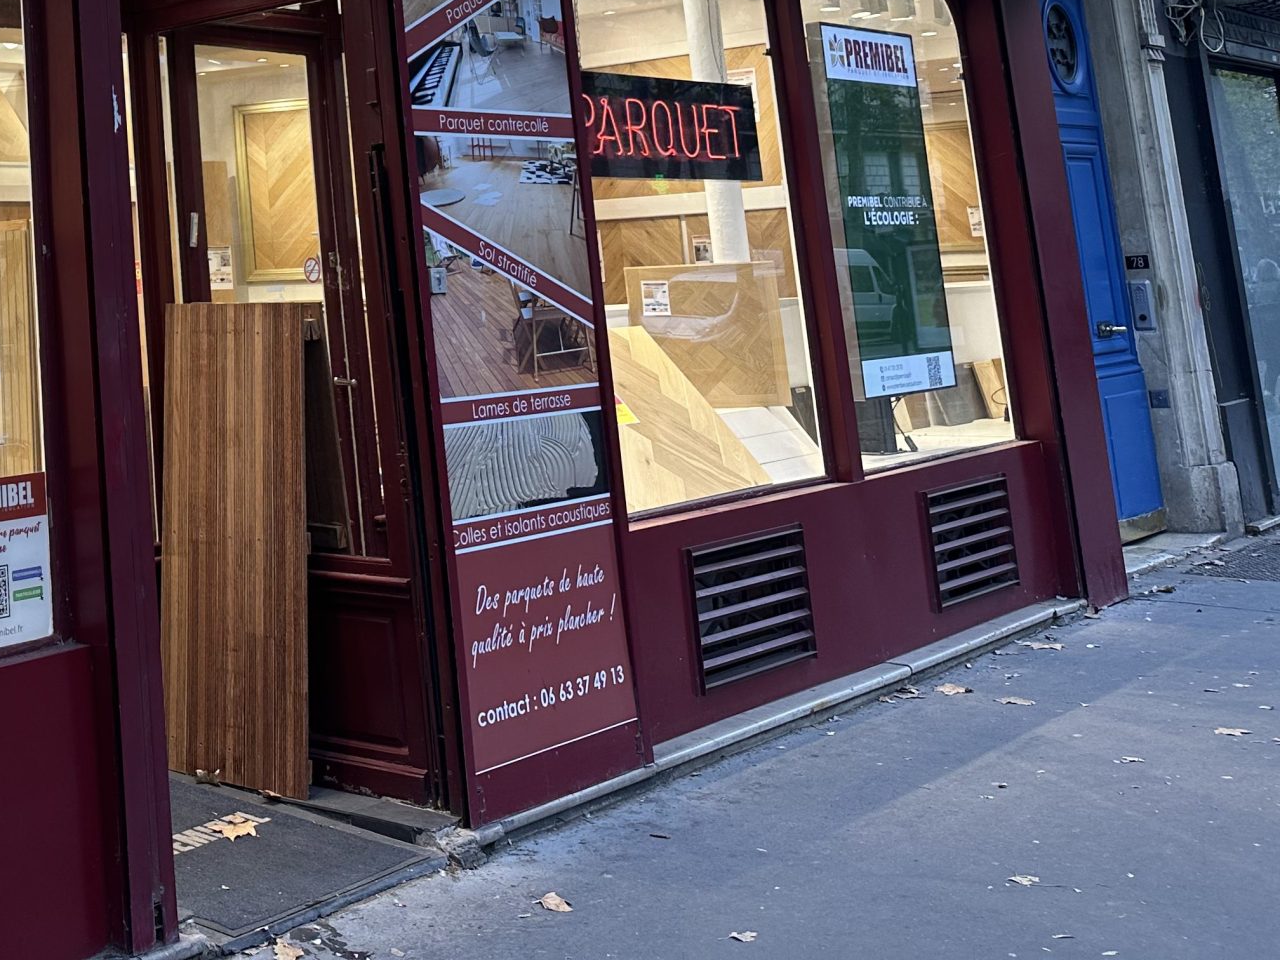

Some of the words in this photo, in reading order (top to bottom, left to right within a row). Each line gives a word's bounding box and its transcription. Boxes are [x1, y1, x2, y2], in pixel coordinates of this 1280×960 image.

[844, 38, 908, 74] PREMIBEL
[439, 114, 485, 134] Parquet
[487, 116, 550, 133] contrecollé
[847, 196, 883, 208] PREMIBEL
[883, 196, 922, 208] CONTRIBUE
[863, 208, 915, 225] L'ÉCOLOGIE
[478, 241, 495, 264] Sol
[496, 252, 538, 288] stratifié
[1130, 256, 1145, 268] 78
[472, 398, 513, 420] Lames
[513, 396, 528, 414] de
[529, 392, 571, 411] terrasse
[9, 522, 43, 542] parquet
[489, 522, 503, 539] et
[504, 514, 546, 536] isolants
[548, 502, 611, 527] acoustiques
[475, 584, 500, 617] Des
[503, 574, 555, 617] parquets
[558, 568, 572, 592] de
[575, 562, 605, 588] haute
[471, 623, 515, 668] qualité
[518, 621, 527, 644] à
[529, 614, 553, 652] prix
[556, 604, 605, 645] plancher
[608, 593, 616, 621] !
[477, 694, 531, 728] contact
[540, 687, 556, 708] 06
[559, 681, 574, 703] 63
[576, 675, 590, 697] 37
[593, 670, 607, 692] 49
[609, 665, 625, 685] 13
